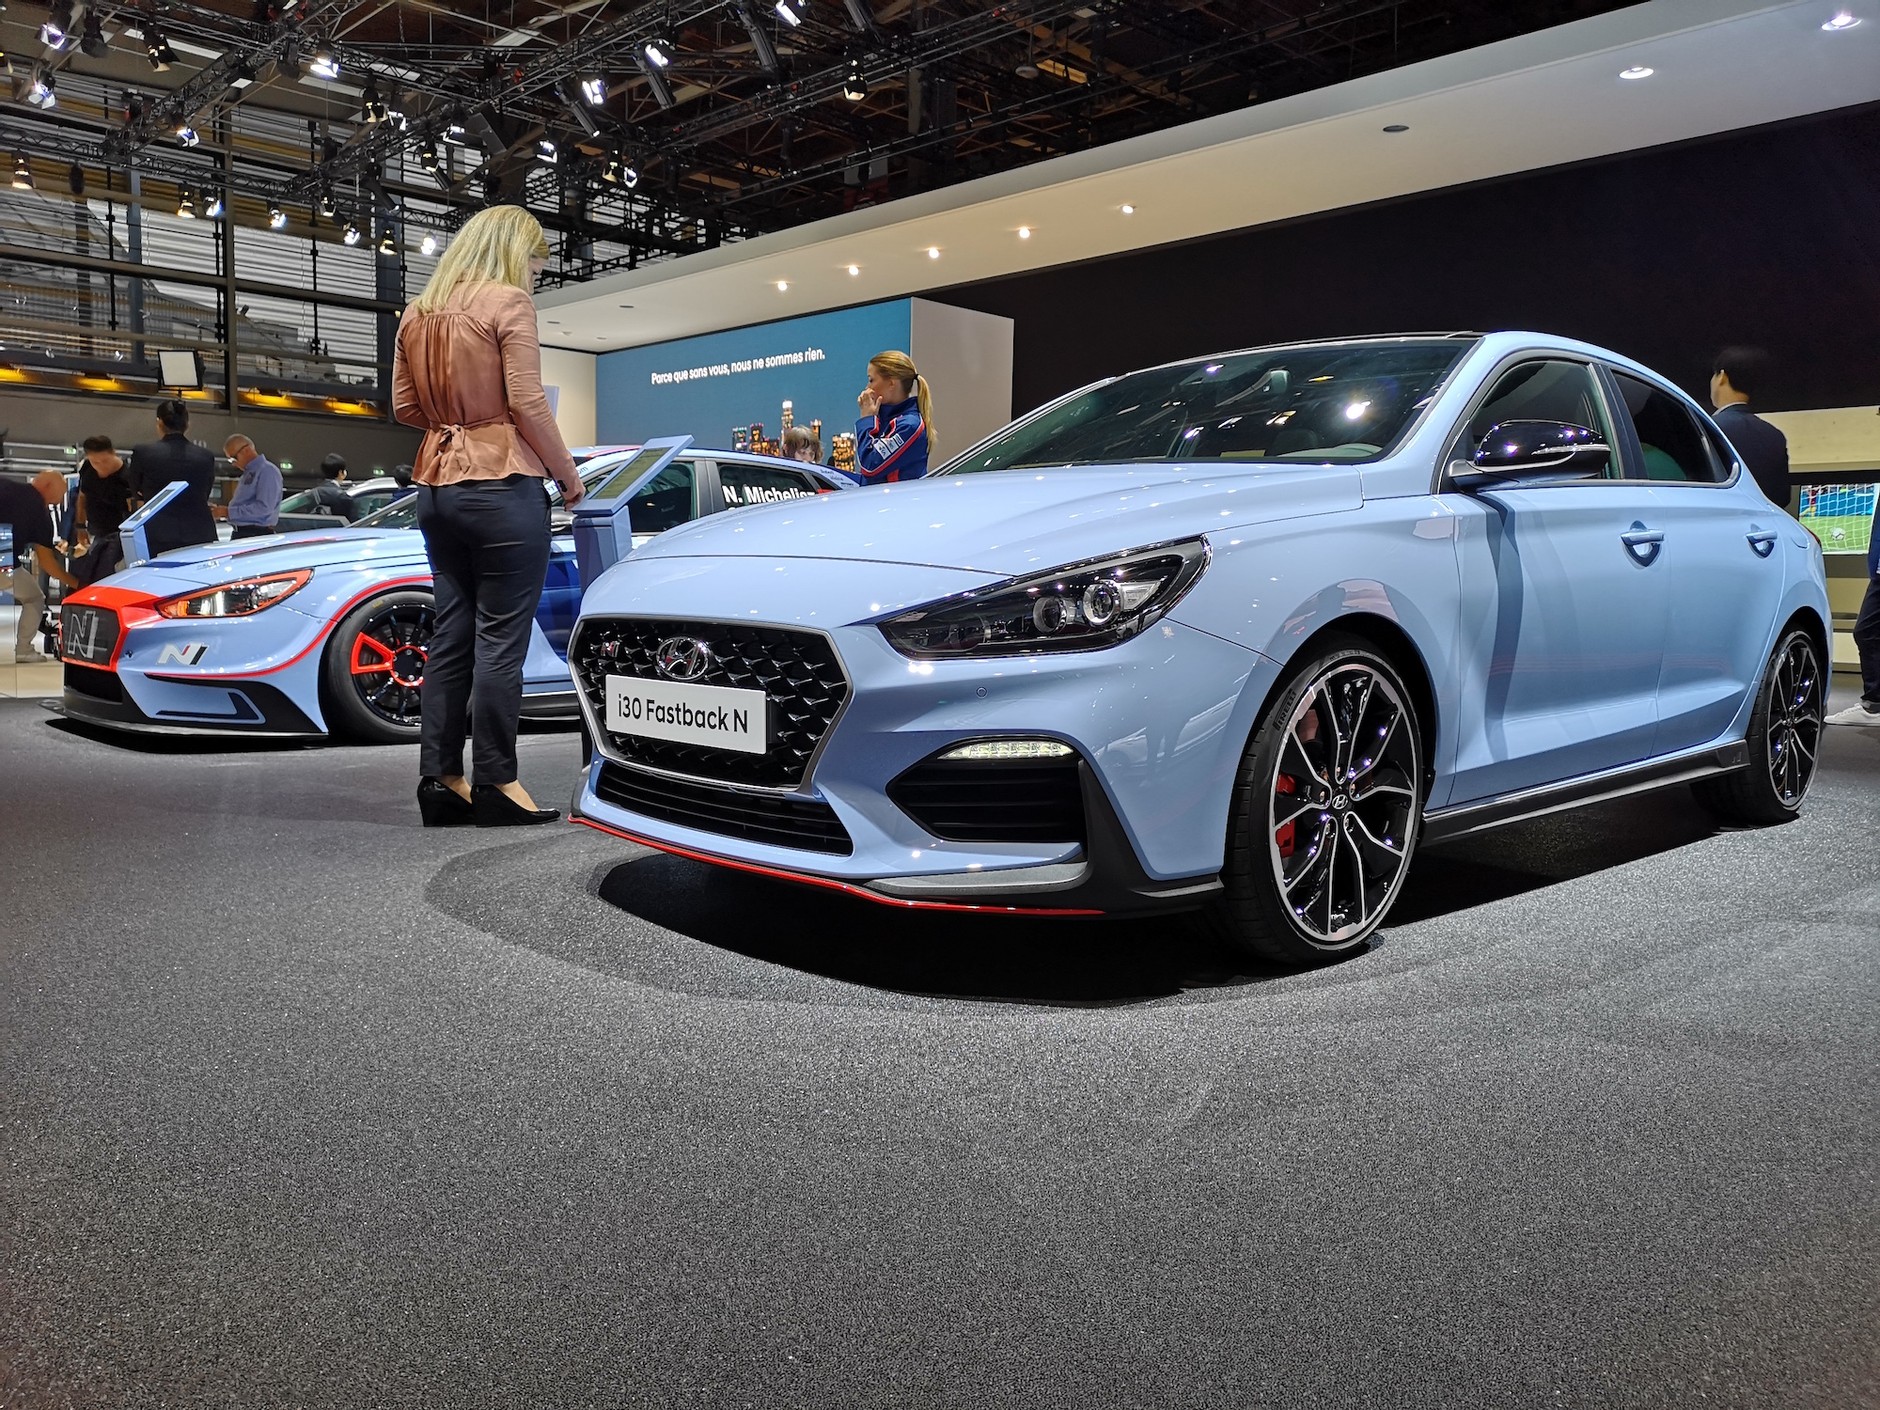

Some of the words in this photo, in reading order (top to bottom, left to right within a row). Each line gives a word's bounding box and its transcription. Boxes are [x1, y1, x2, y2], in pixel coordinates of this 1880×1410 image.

[651, 372, 672, 385] Parce
[673, 370, 688, 383] que
[689, 367, 708, 380] sans
[708, 363, 730, 376] vous,
[731, 360, 752, 373] nous
[752, 357, 765, 370] ne
[765, 350, 804, 367] sommes
[804, 347, 826, 361] rien.
[722, 485, 743, 503] N.
[618, 693, 642, 719] i30
[646, 699, 729, 731] Fastback
[733, 708, 748, 733] N
